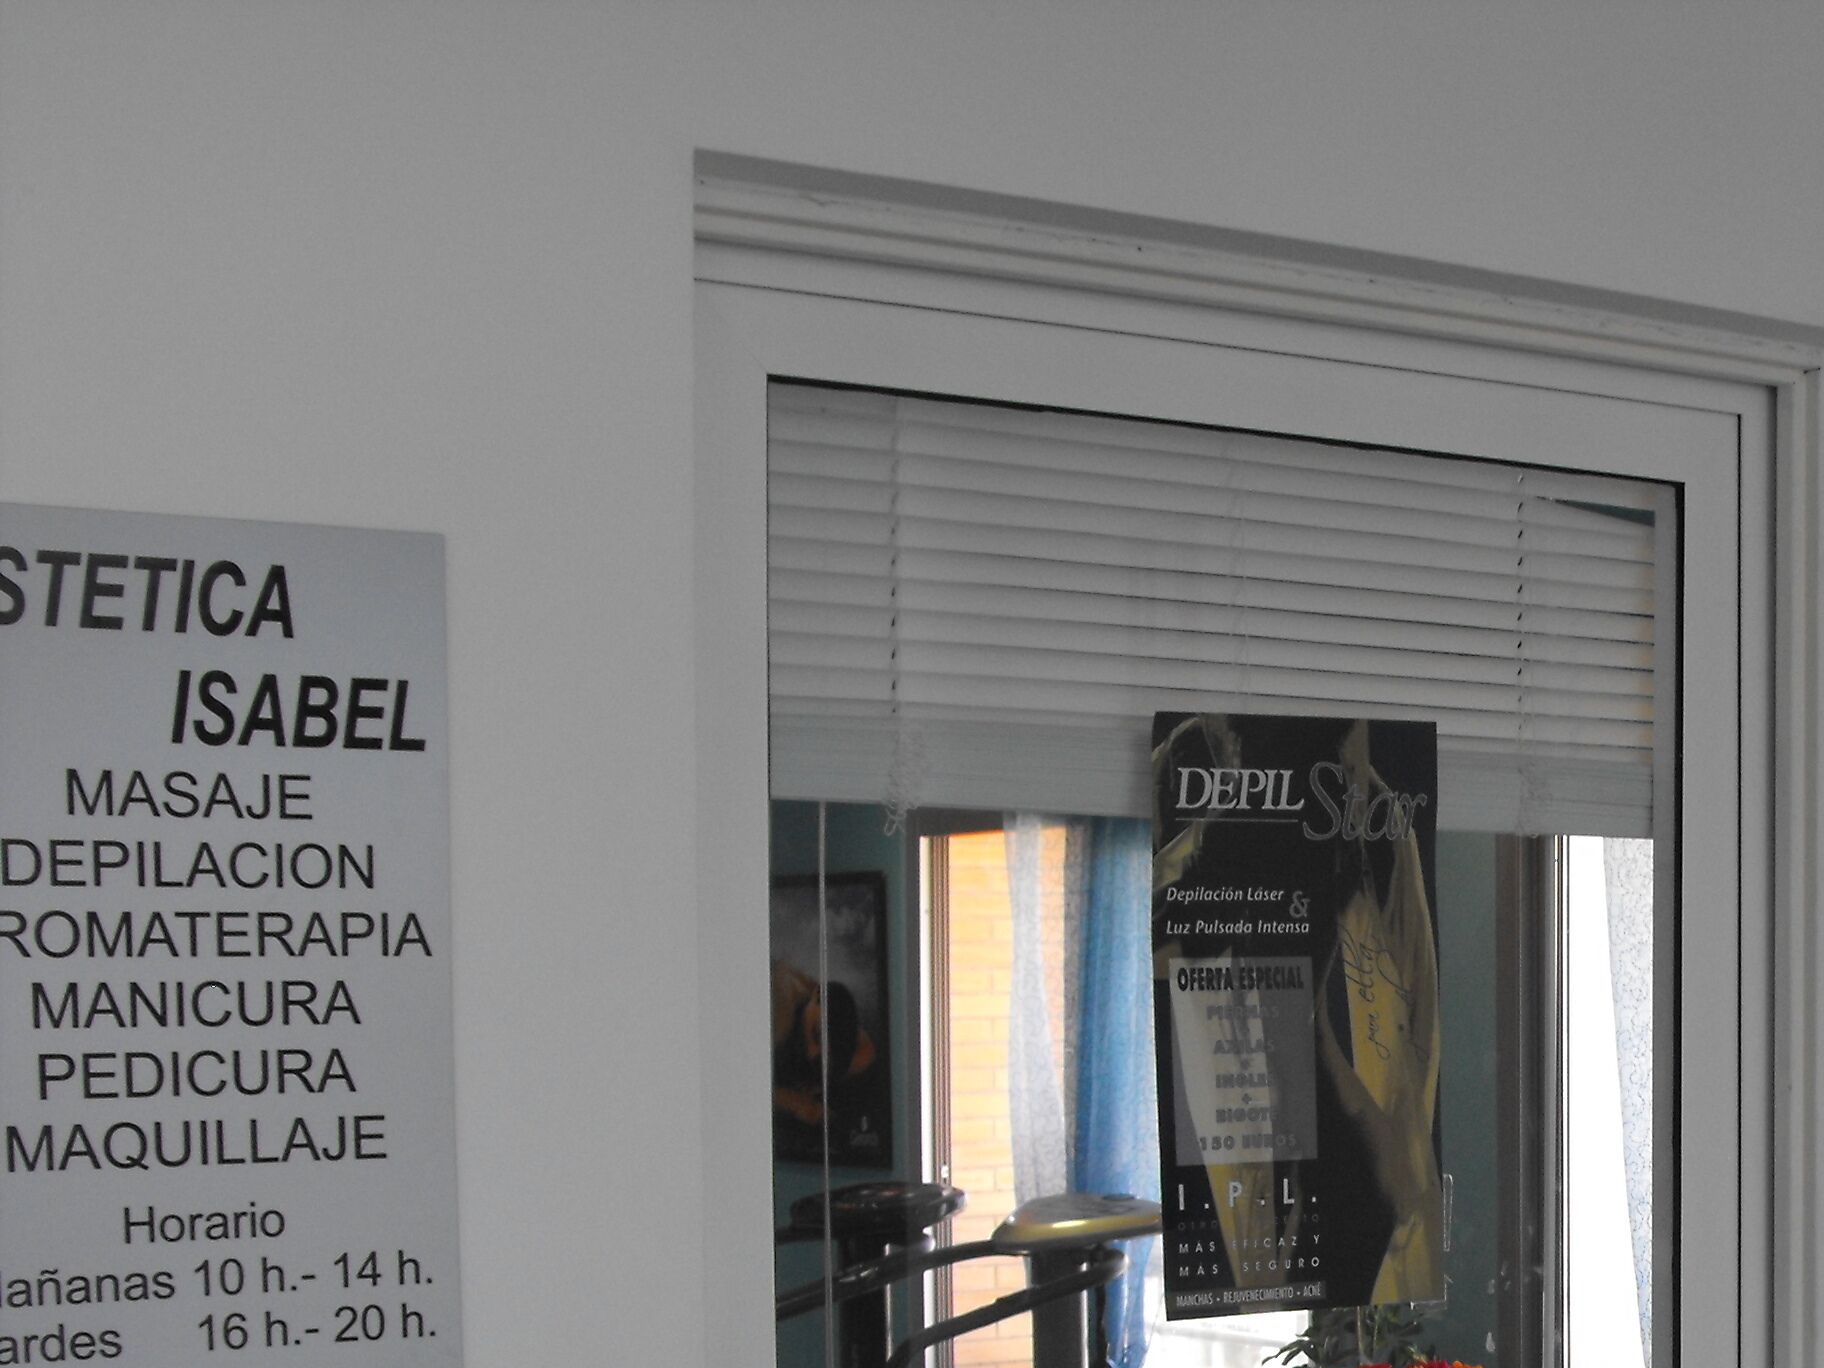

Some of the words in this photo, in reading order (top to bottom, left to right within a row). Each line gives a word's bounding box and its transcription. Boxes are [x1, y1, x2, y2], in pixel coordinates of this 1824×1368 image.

[172, 670, 426, 751] ISABEL
[65, 768, 313, 820] MASAJE
[1176, 767, 1305, 811] DEPIL
[1303, 761, 1428, 842] Star
[1, 838, 375, 889] DEPILACION
[1166, 887, 1243, 904] Depilación
[1247, 887, 1284, 902] Láser
[1166, 920, 1190, 934] Luz
[1195, 920, 1252, 934] Pulsada
[1257, 919, 1310, 934] Intensa
[1177, 966, 1234, 992] OFERTA
[1239, 965, 1305, 991] ESPECIAL
[31, 980, 361, 1029] MANICURA
[37, 1048, 357, 1100] PEDICURA
[5, 1115, 387, 1172] MAQUILLAJE
[123, 1202, 285, 1244] Horario
[0, 1267, 176, 1308] añanas
[195, 1258, 244, 1297] 10
[333, 1250, 381, 1288] 14
[398, 1248, 434, 1286] h.
[1243, 1257, 1321, 1273] SEGURO
[199, 1313, 248, 1351] 16
[334, 1304, 385, 1343] 20
[402, 1302, 436, 1338] h.
